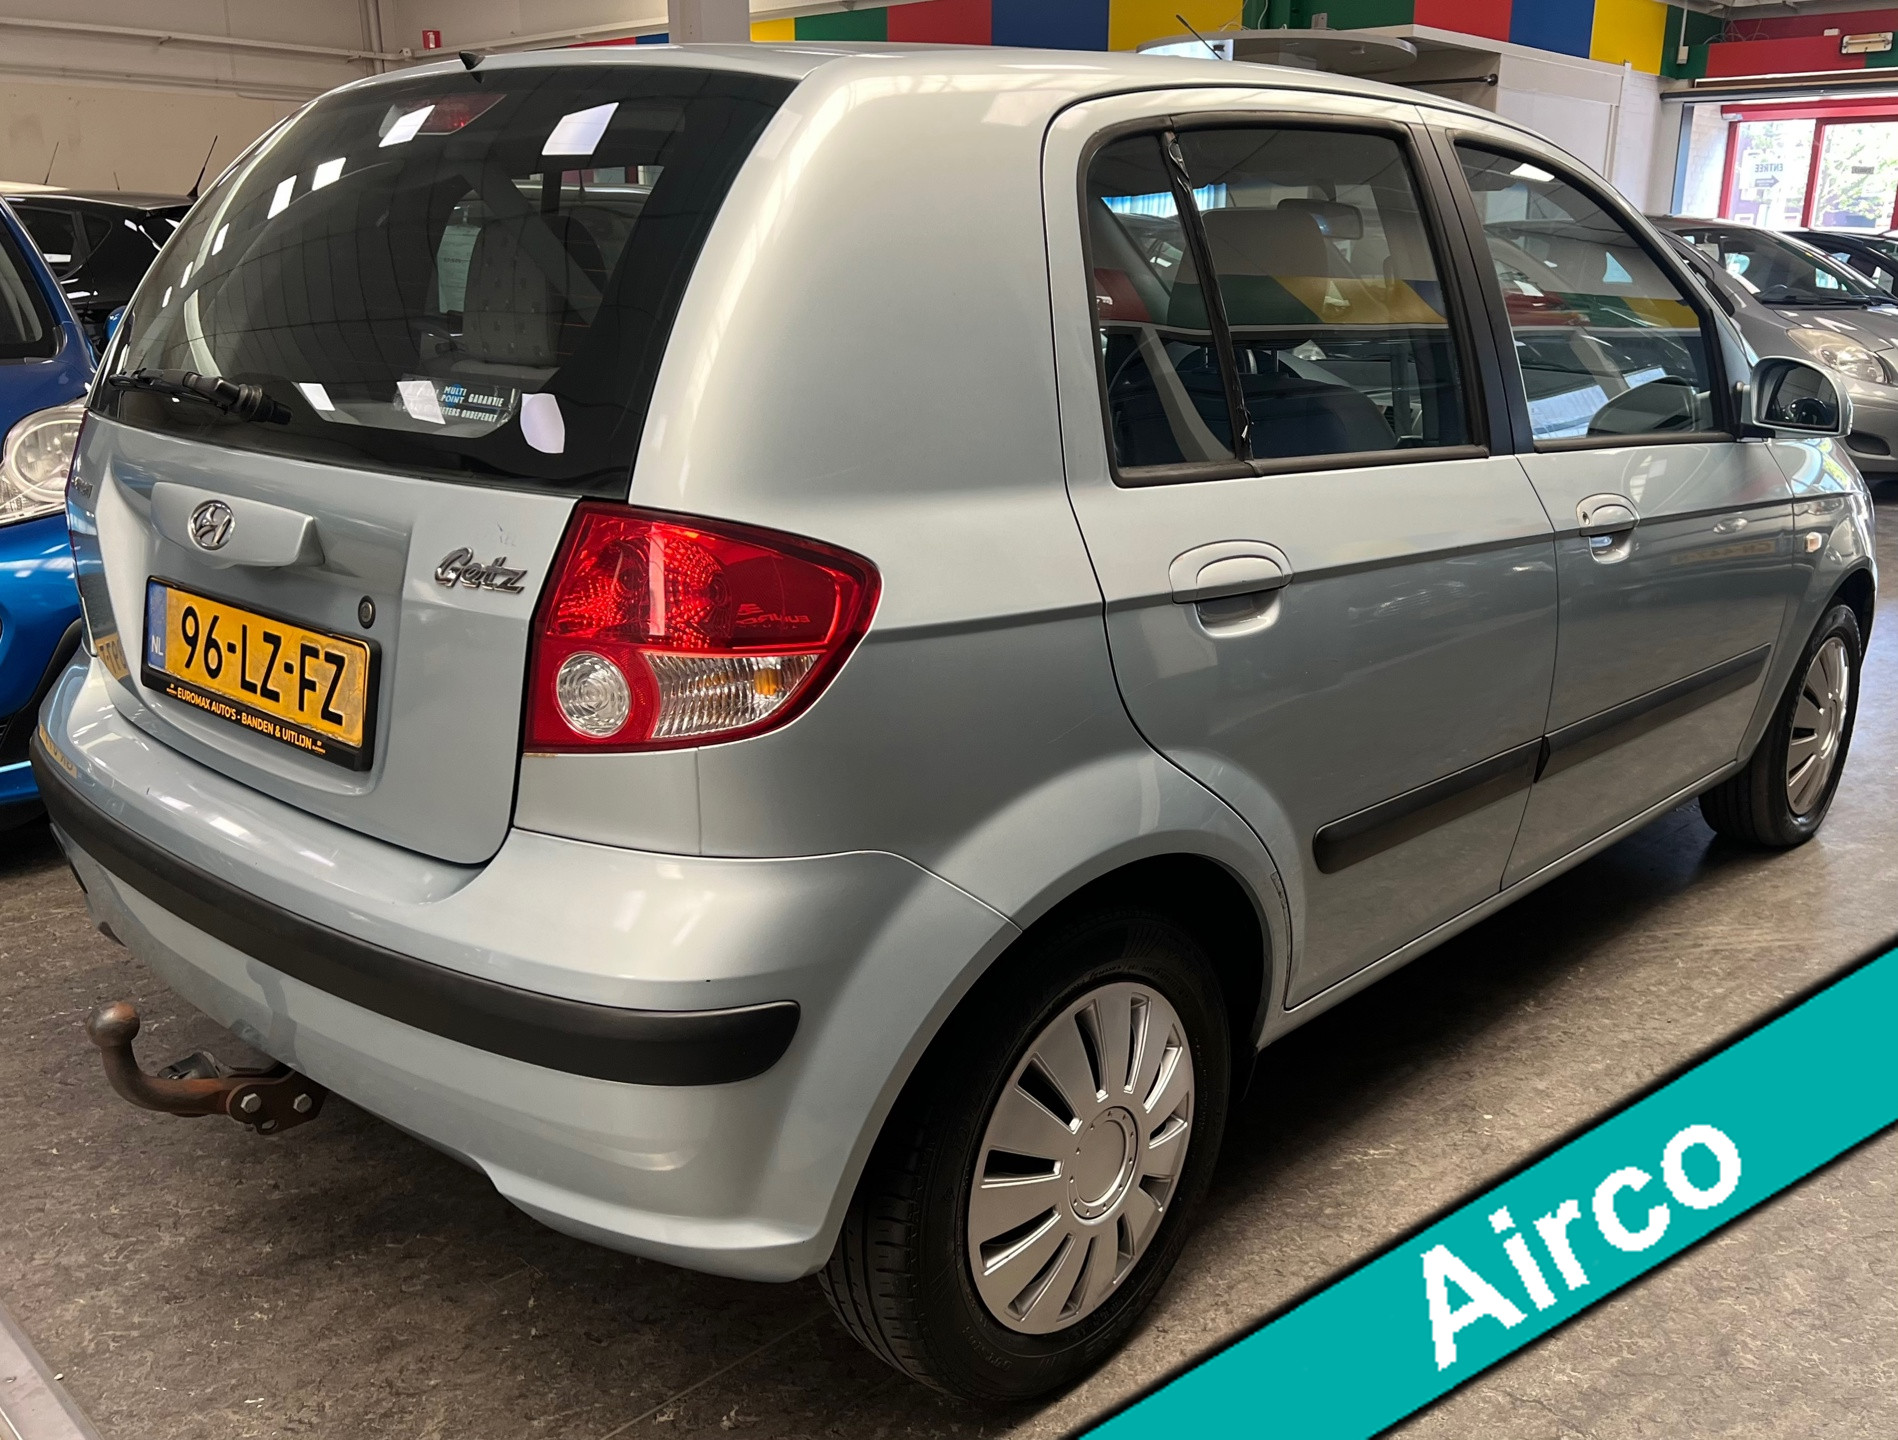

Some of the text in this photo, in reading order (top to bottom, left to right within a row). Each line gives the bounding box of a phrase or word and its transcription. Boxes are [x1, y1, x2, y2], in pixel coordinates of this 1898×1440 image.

[441, 393, 505, 407] POINT GARANTIE
[443, 386, 467, 396] MULTI
[435, 546, 528, 595] Getz
[151, 635, 164, 656] NL
[181, 605, 346, 727] 96-LZ-FZ
[177, 687, 211, 711] EUROMAX
[211, 701, 237, 721] AUTO'S
[241, 712, 274, 736] BANDEN
[274, 726, 281, 738] &
